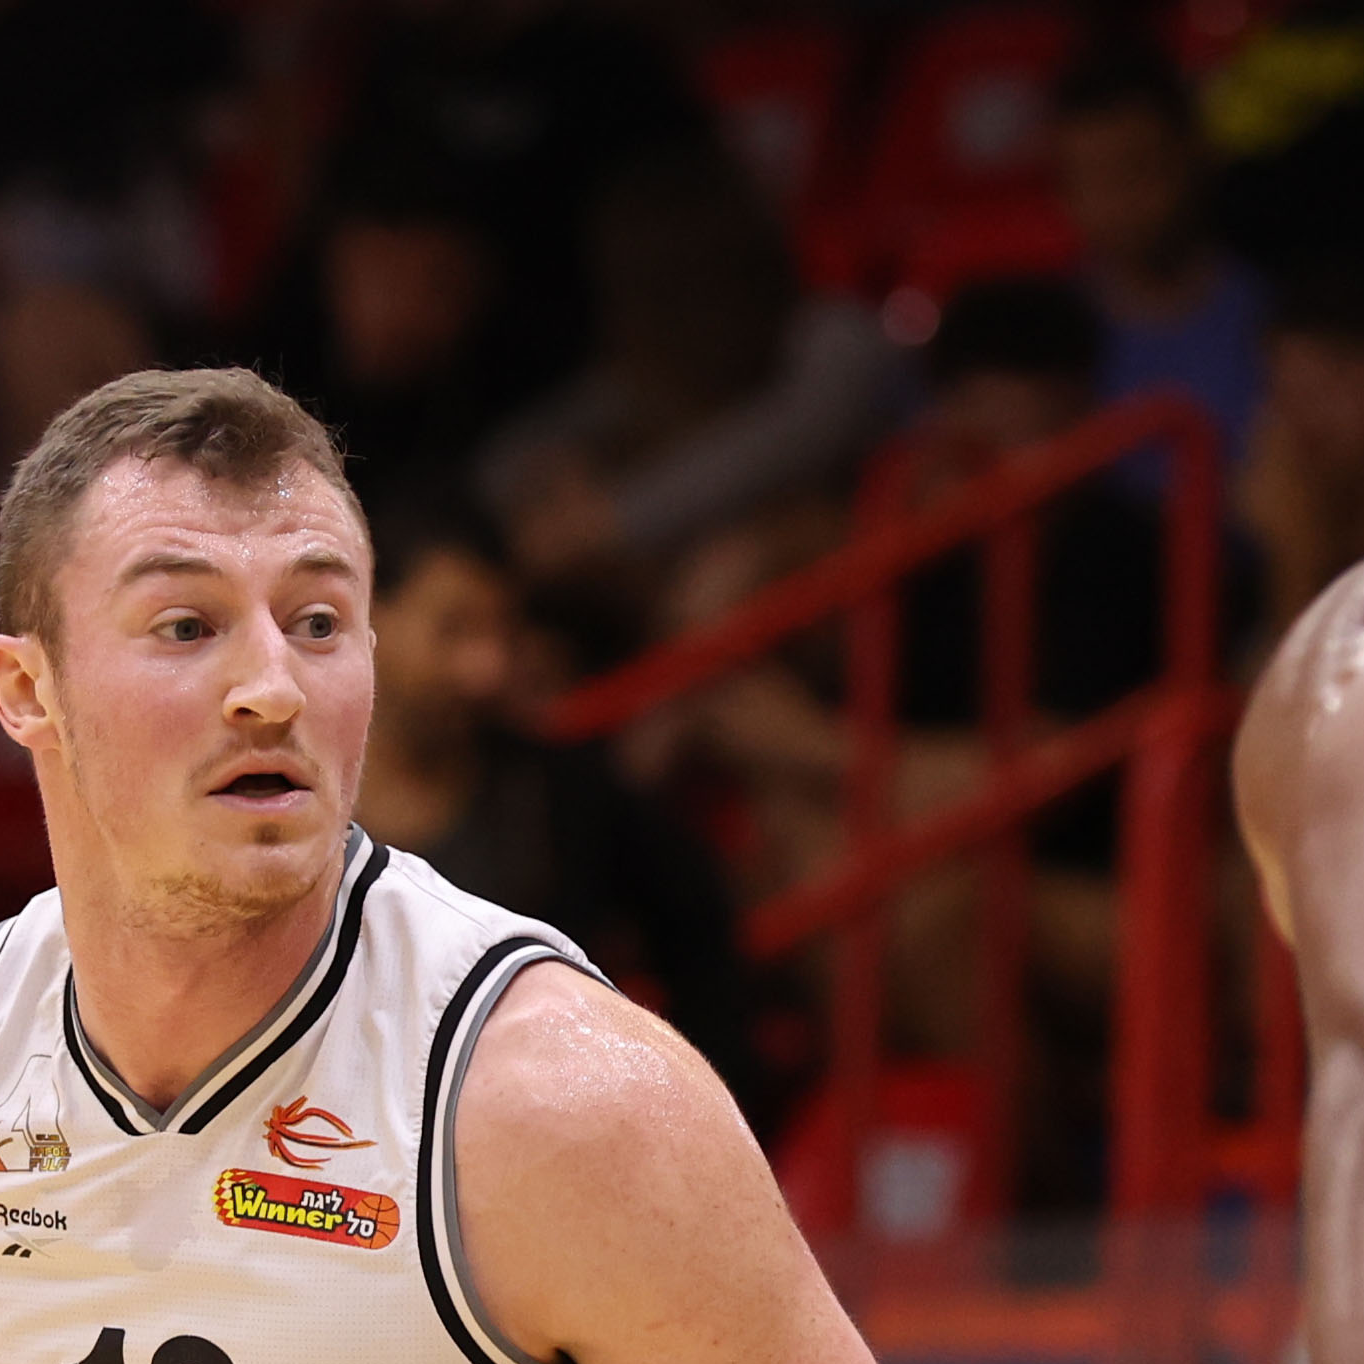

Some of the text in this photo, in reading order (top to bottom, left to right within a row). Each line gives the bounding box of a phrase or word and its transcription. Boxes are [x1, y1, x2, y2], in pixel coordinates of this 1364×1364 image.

[232, 1184, 376, 1238] Winner סל
[300, 1189, 343, 1212] ליגת
